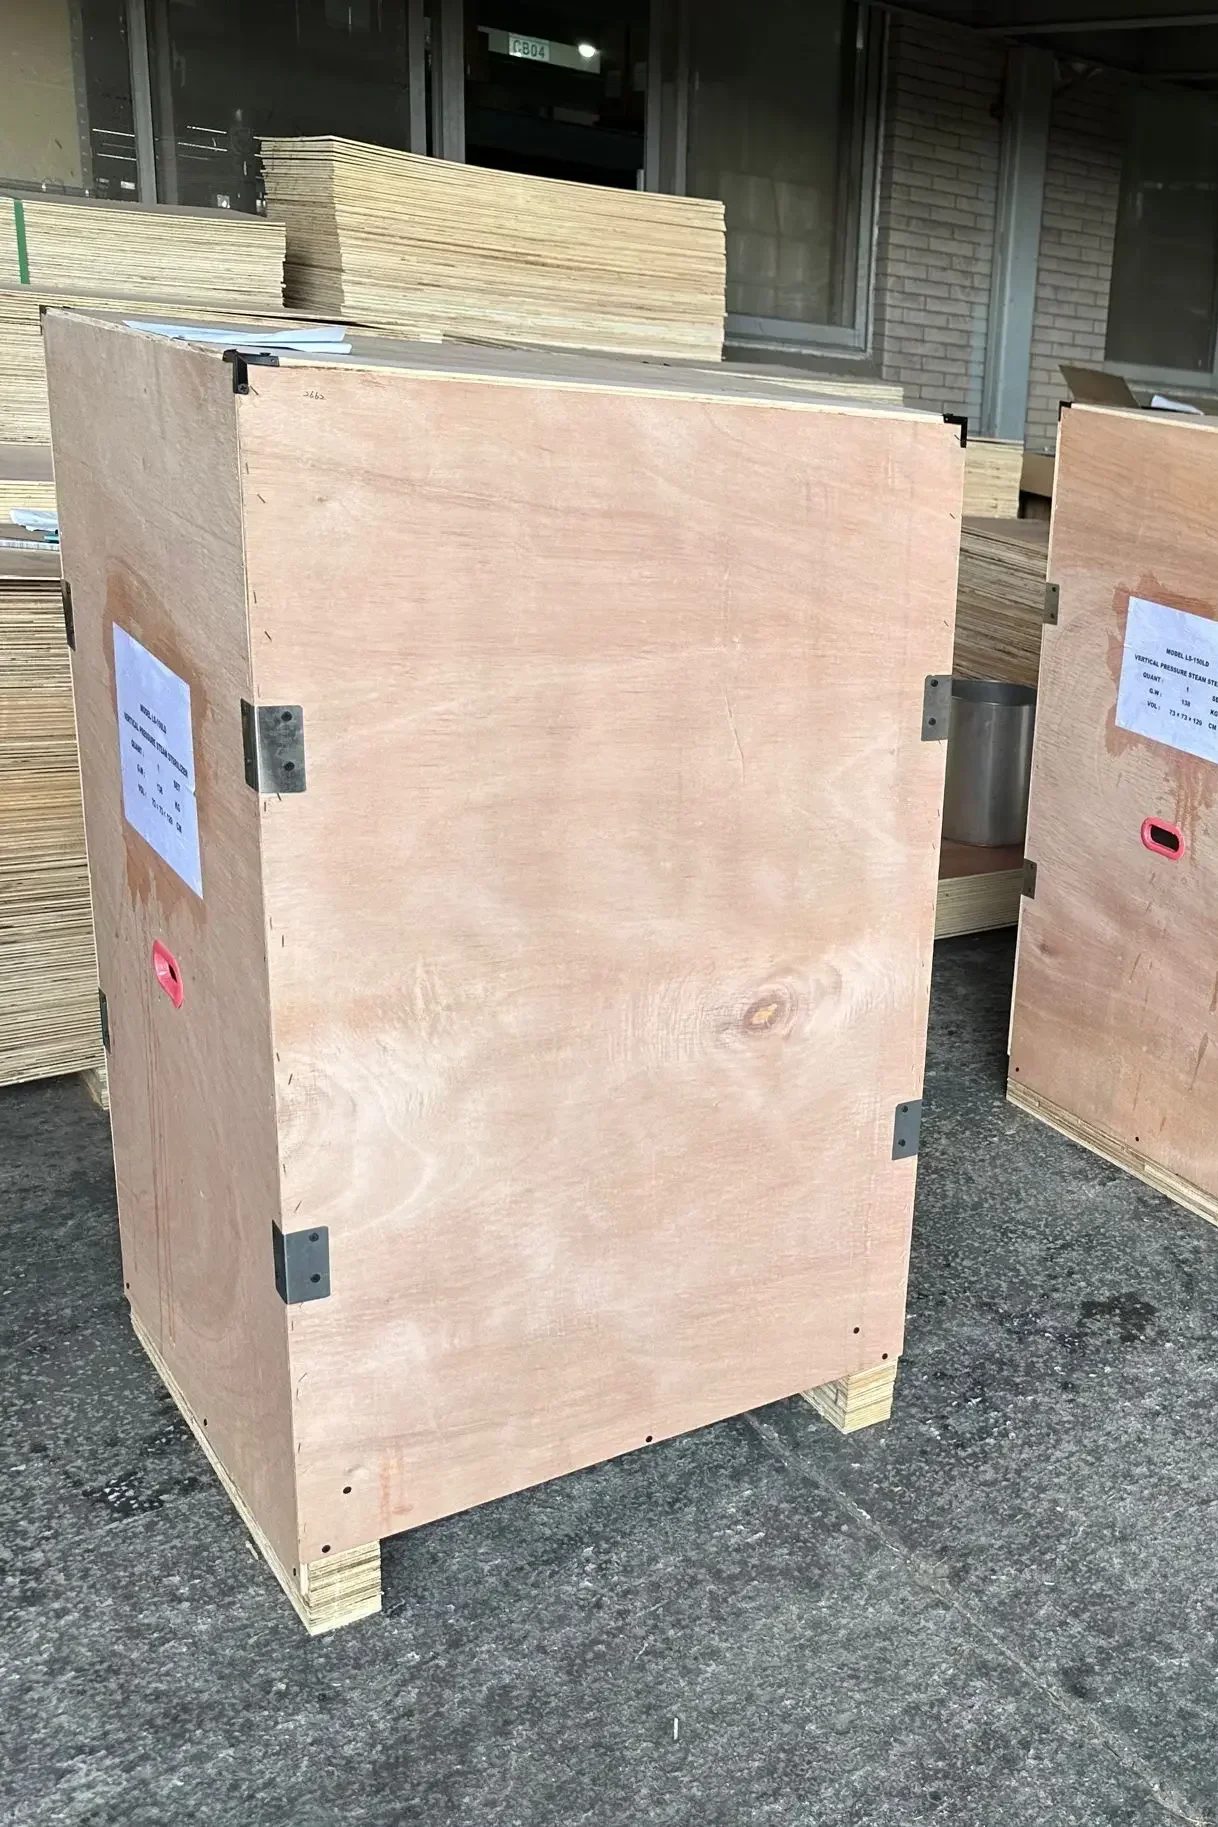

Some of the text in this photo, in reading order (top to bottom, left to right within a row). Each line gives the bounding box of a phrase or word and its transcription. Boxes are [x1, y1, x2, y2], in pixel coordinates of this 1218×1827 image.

[513, 40, 545, 59] CB04
[1166, 648, 1184, 660] MODEL
[1134, 653, 1159, 668] VERTICAL
[1160, 662, 1188, 677] PRESSURE
[1188, 671, 1207, 683] STEAM
[1210, 709, 1218, 717] KG
[1208, 722, 1217, 731] CM
